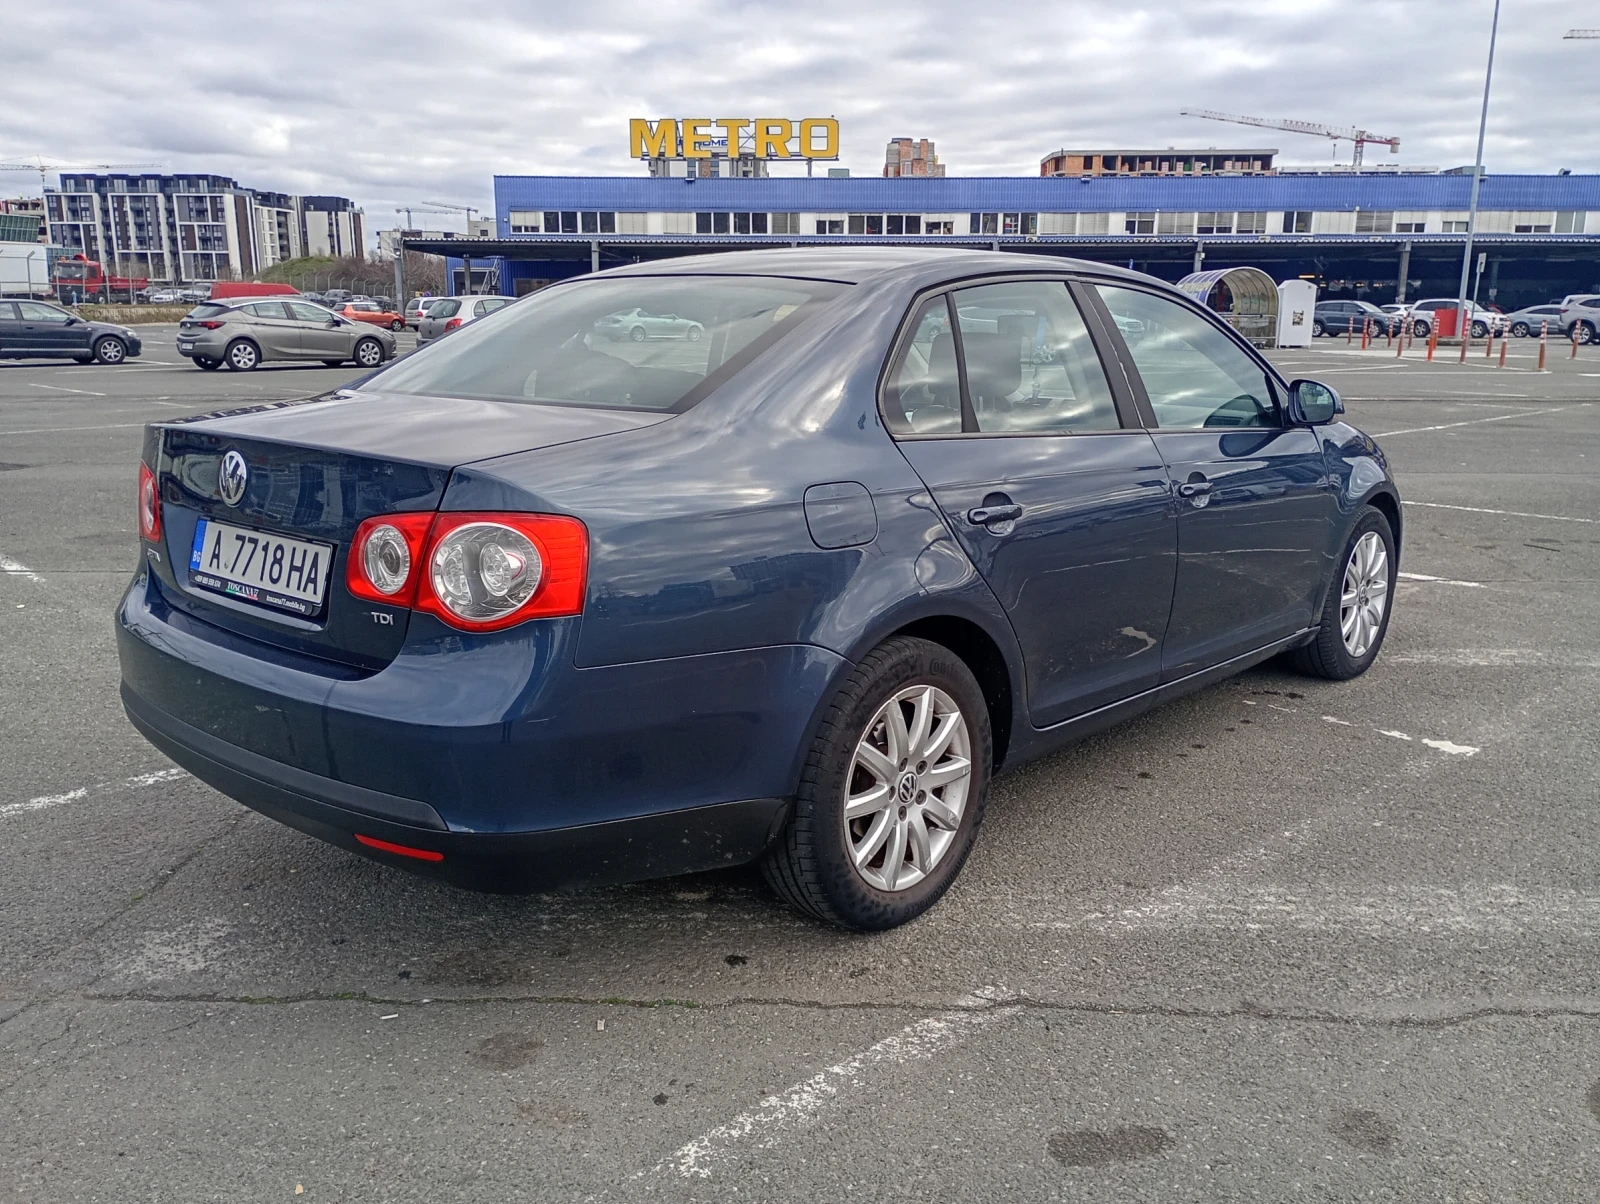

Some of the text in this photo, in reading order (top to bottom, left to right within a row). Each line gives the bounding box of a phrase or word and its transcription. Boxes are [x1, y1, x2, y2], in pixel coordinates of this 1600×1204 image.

[629, 118, 839, 158] METRO
[192, 550, 202, 563] BG
[209, 530, 222, 570] A
[230, 533, 285, 584] 7718
